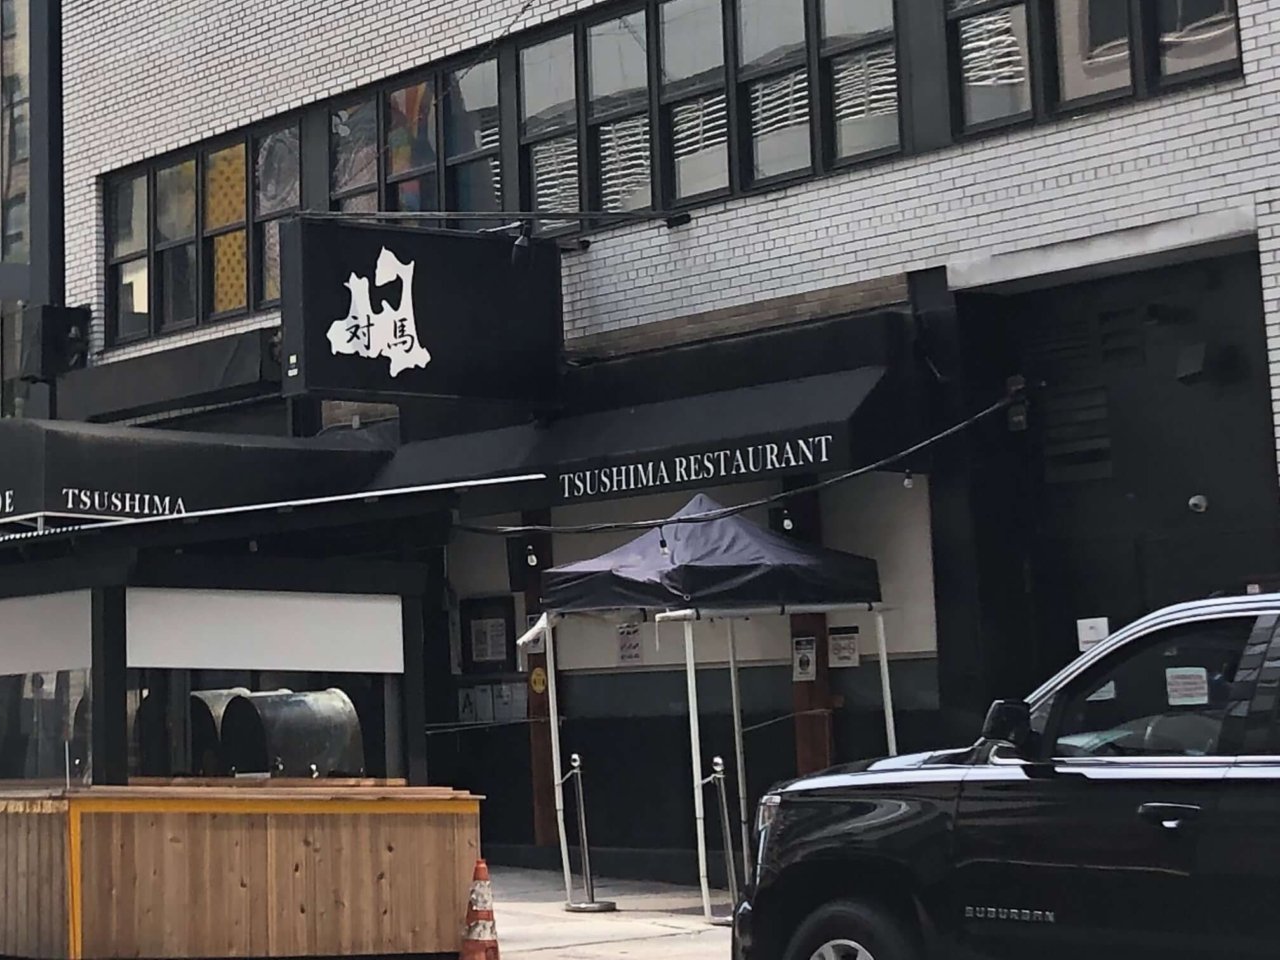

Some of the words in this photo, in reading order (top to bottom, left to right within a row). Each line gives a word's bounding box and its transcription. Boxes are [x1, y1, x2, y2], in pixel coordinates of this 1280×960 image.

[345, 315, 414, 354] 対馬
[560, 460, 670, 498] TSUSHIMA
[675, 435, 833, 483] RESTAURANT
[62, 488, 186, 515] TSUSHIMA
[965, 906, 1055, 923] SUBURBAN
